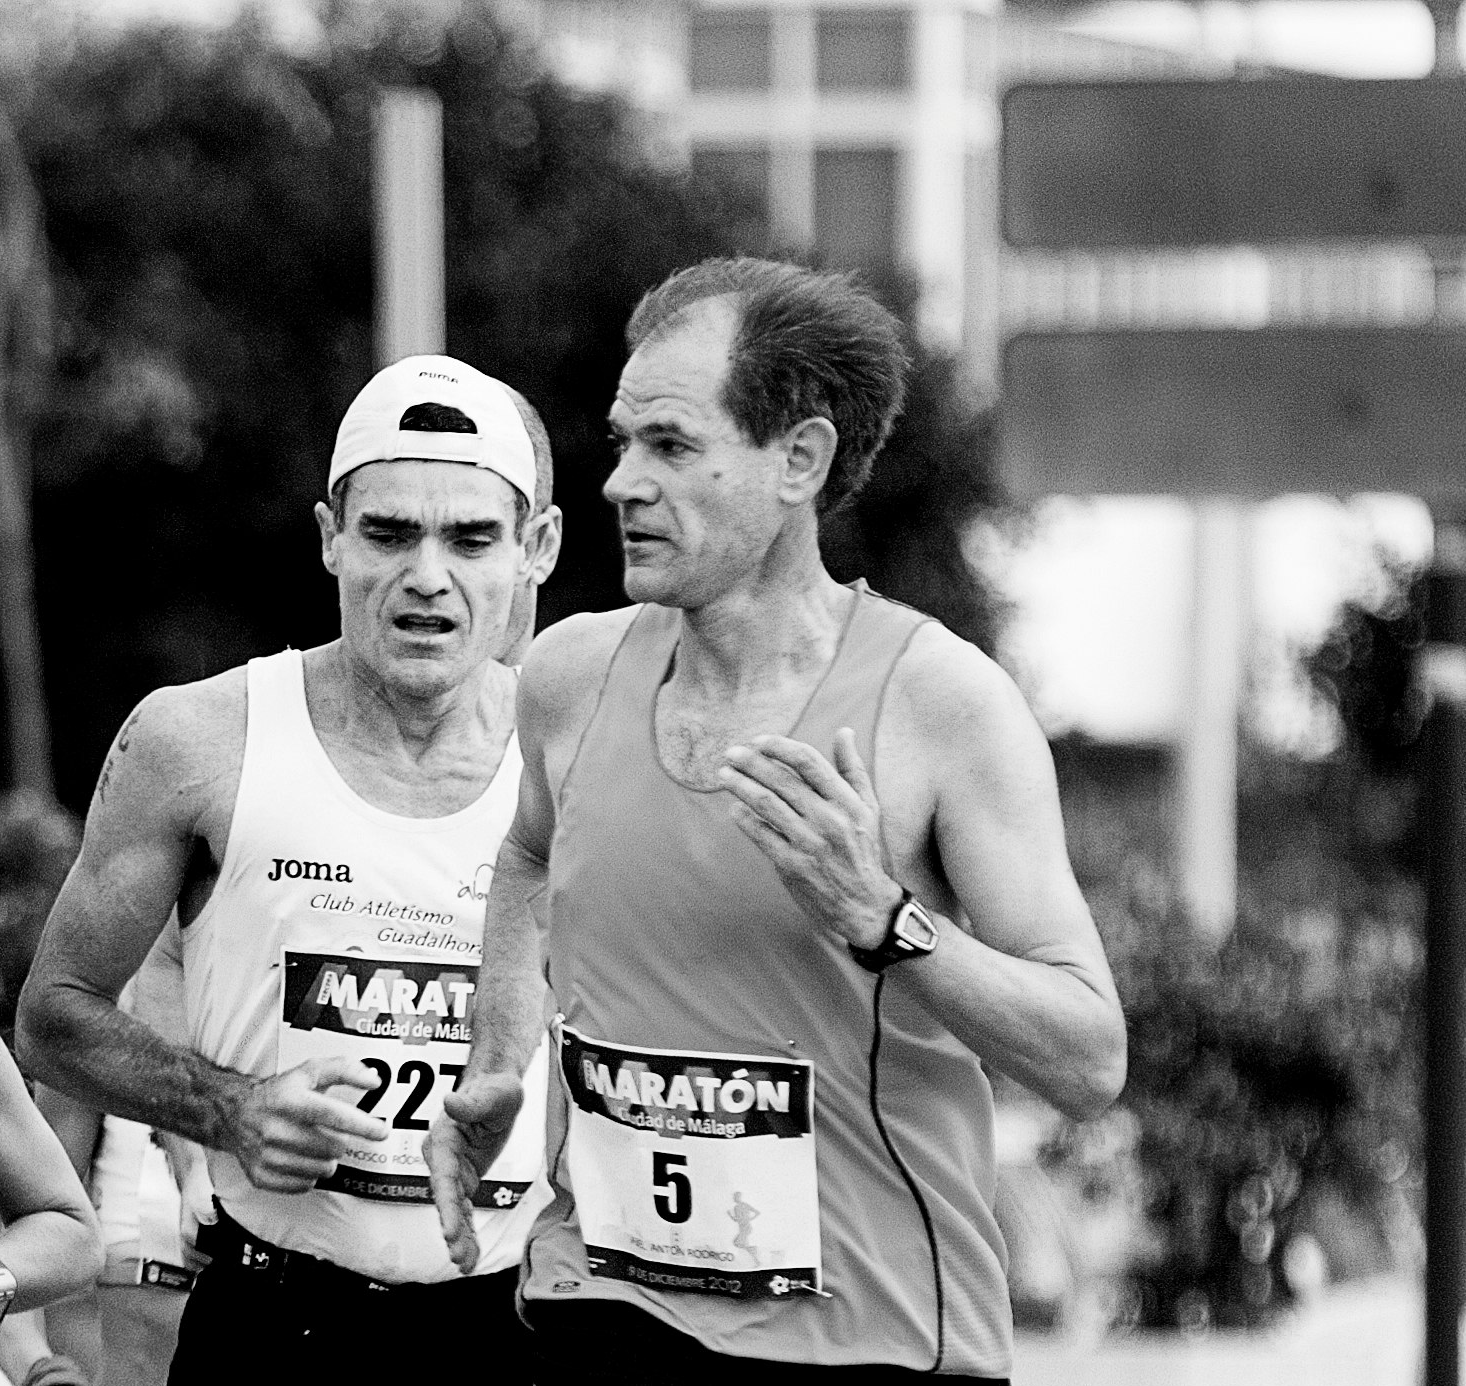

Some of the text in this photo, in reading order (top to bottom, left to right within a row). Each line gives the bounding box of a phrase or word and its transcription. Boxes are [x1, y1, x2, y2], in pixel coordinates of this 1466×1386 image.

[267, 858, 354, 883] Joma
[310, 893, 454, 926] Club Atletismo
[376, 927, 484, 955] Guadalhor
[315, 970, 476, 1018] MARAT
[356, 1018, 472, 1041] Ciudad de Mála
[583, 1060, 790, 1114] MARATÓN
[620, 1109, 746, 1139] Ciudad de Málaga
[345, 1148, 388, 1164] NCISCO
[352, 1180, 367, 1193] DE
[368, 1183, 430, 1199] DICIEMBRE
[652, 1151, 693, 1224] 5
[687, 1247, 735, 1262] RODRIGO
[708, 1275, 742, 1294] 2012
